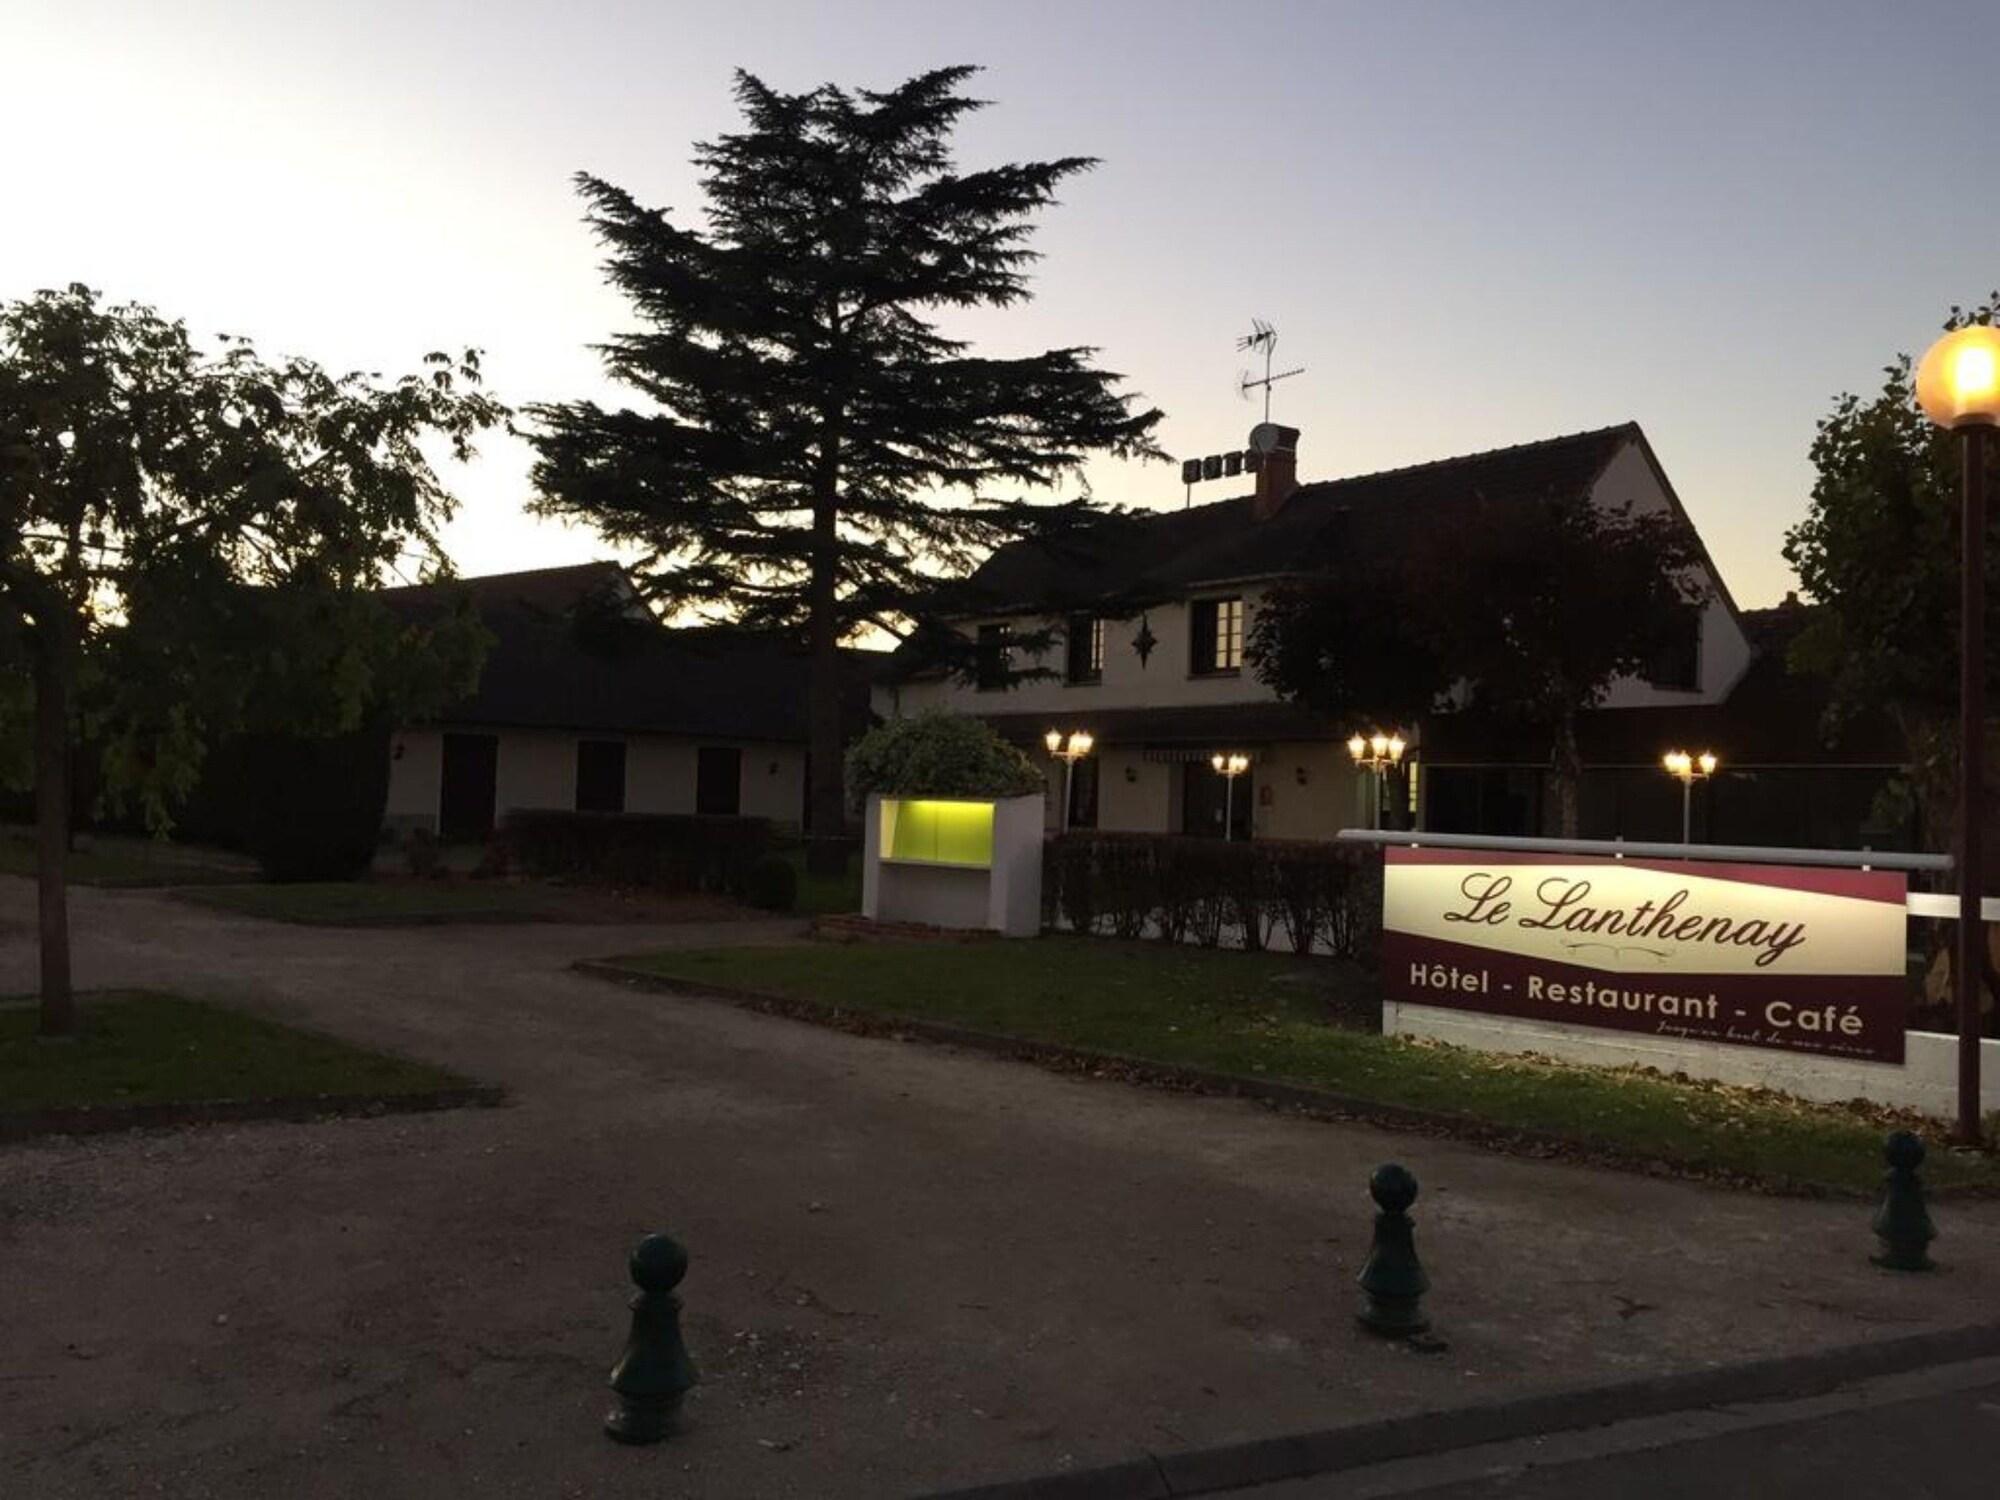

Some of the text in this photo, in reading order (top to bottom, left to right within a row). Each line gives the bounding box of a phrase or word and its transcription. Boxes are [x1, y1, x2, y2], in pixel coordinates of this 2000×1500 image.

[1444, 873, 1808, 967] Le Lanthenay
[1410, 963, 1489, 993] Hôtel
[1528, 975, 1718, 1019] Restaurant
[1765, 1001, 1864, 1035] Café
